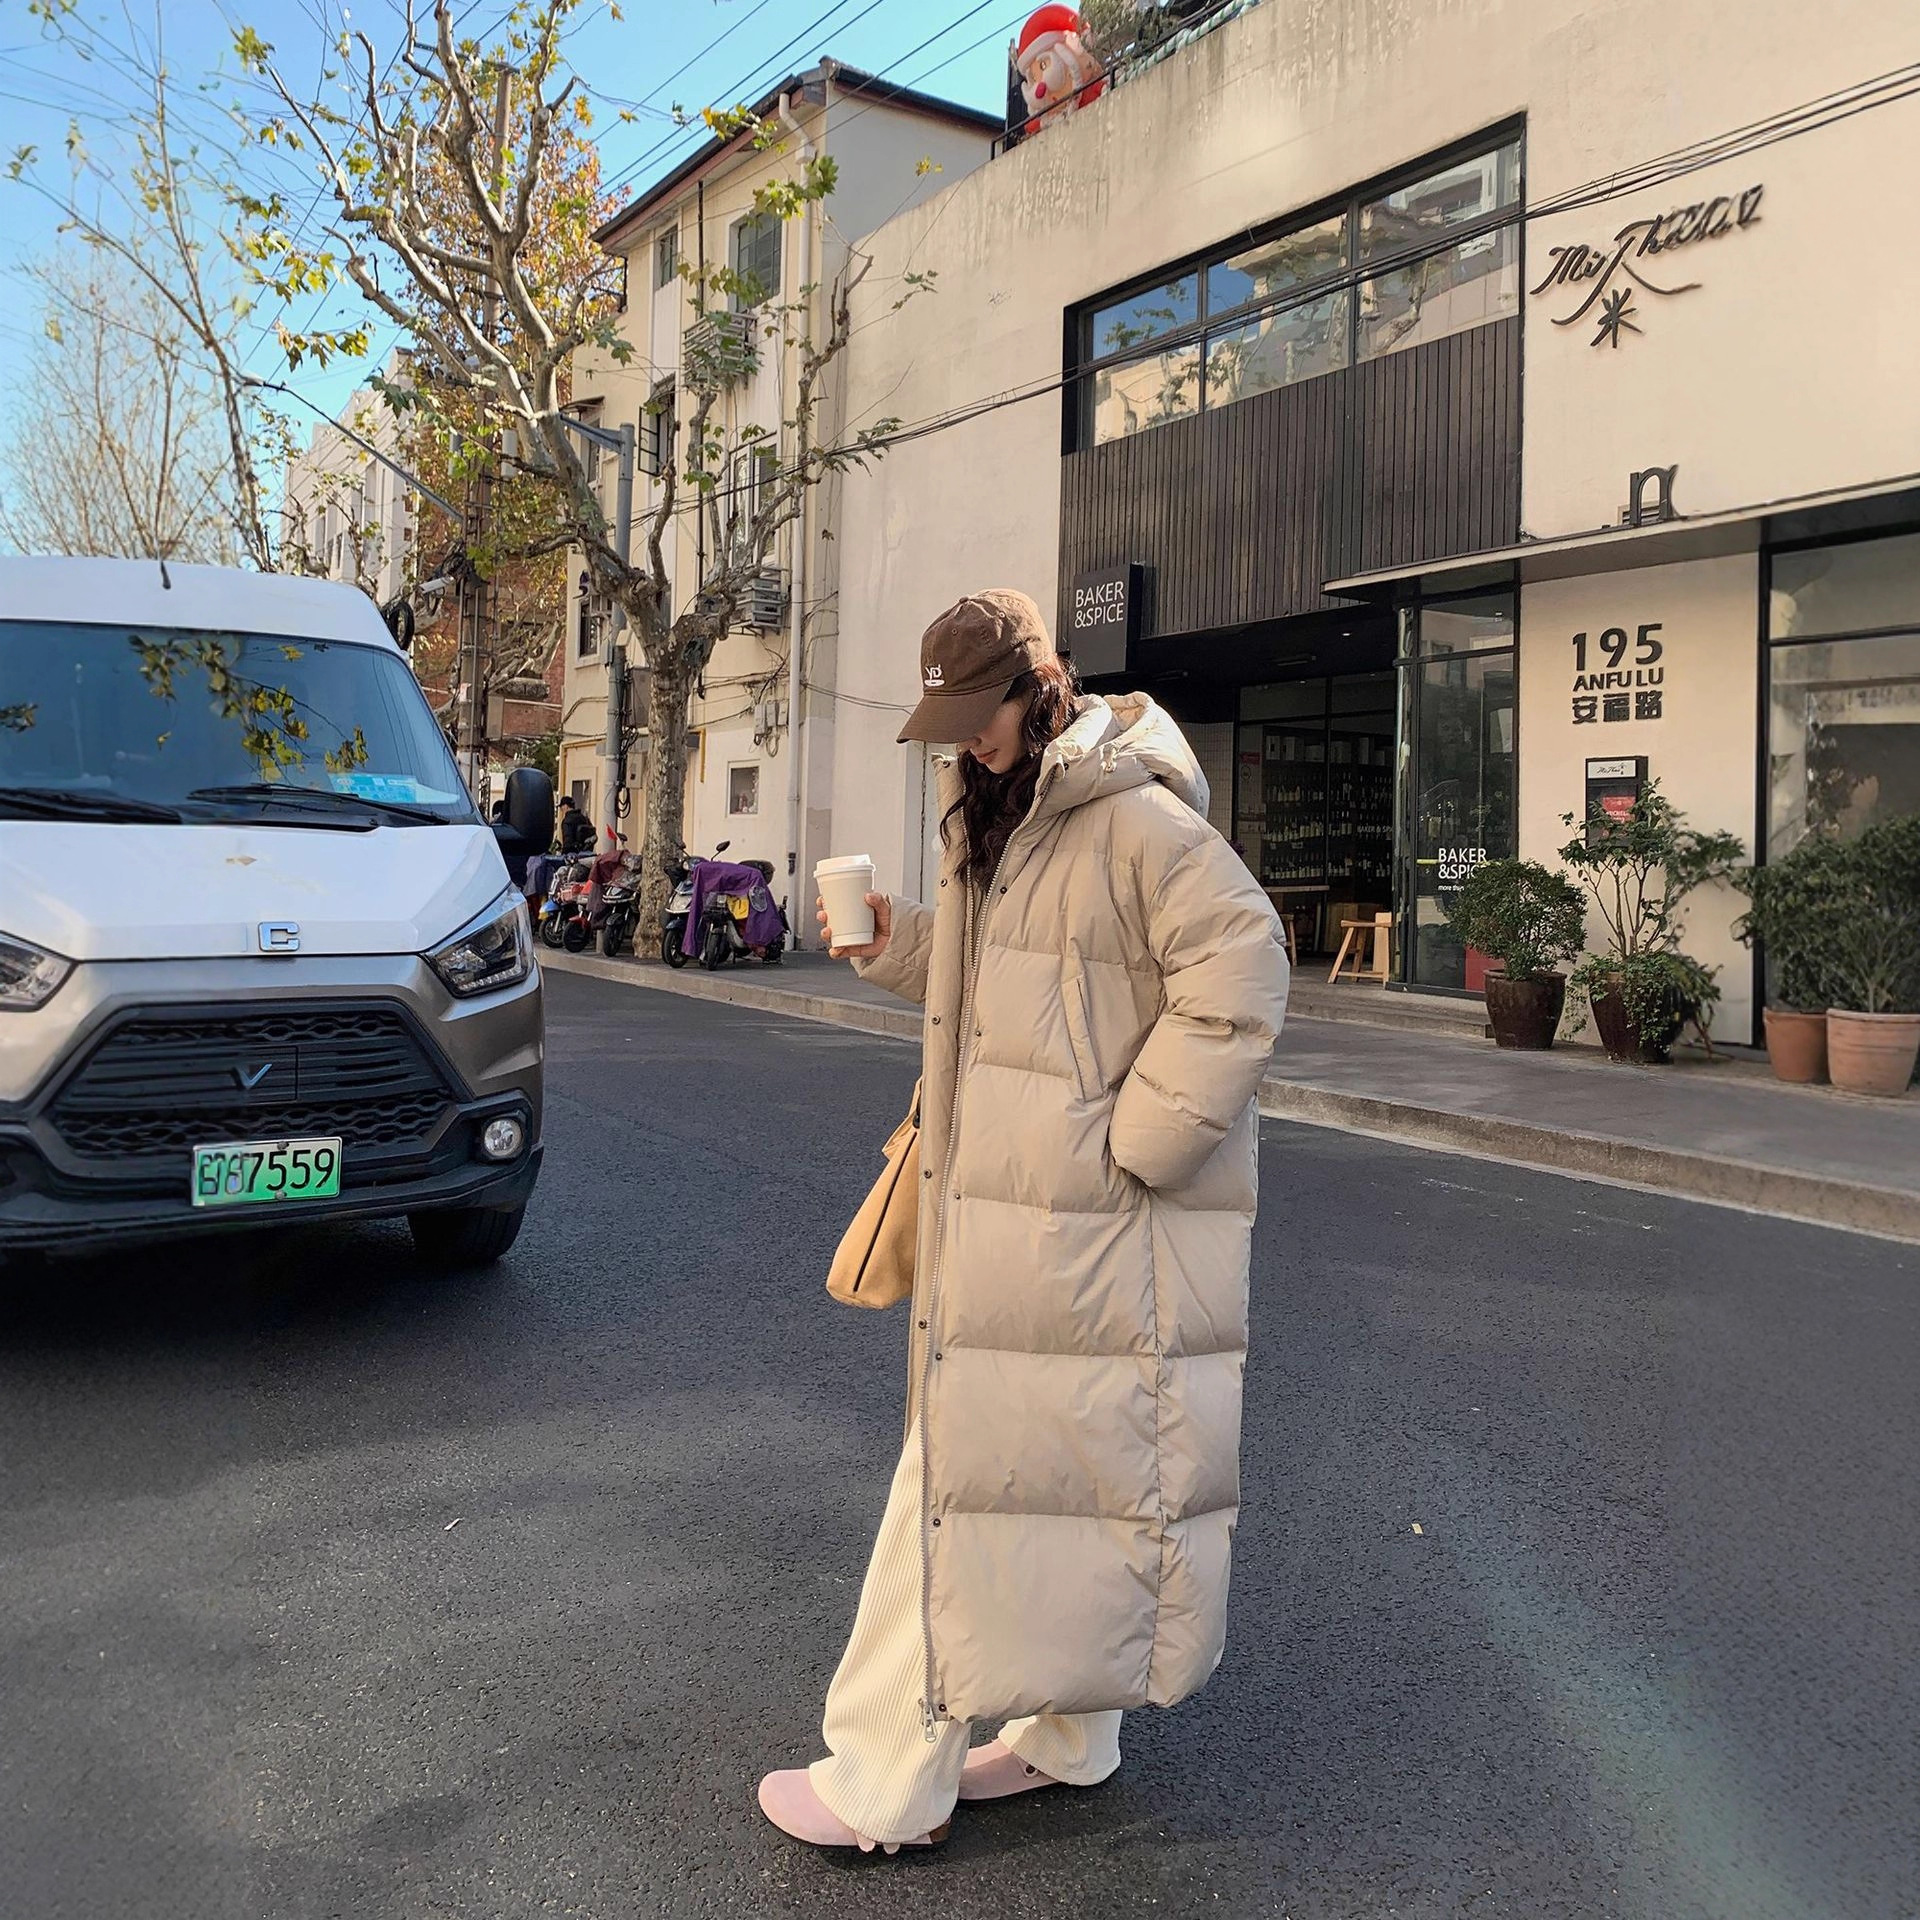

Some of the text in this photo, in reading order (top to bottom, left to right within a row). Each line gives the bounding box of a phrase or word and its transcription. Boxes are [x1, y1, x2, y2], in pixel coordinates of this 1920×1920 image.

[1075, 581, 1125, 608] BAKER
[1074, 602, 1124, 629] &SPICE
[1572, 623, 1663, 671] 195
[1572, 667, 1664, 692] ANFU LU
[1572, 690, 1663, 724] 安福路
[1438, 848, 1487, 863] BAKER
[1438, 864, 1480, 879] &SPIC
